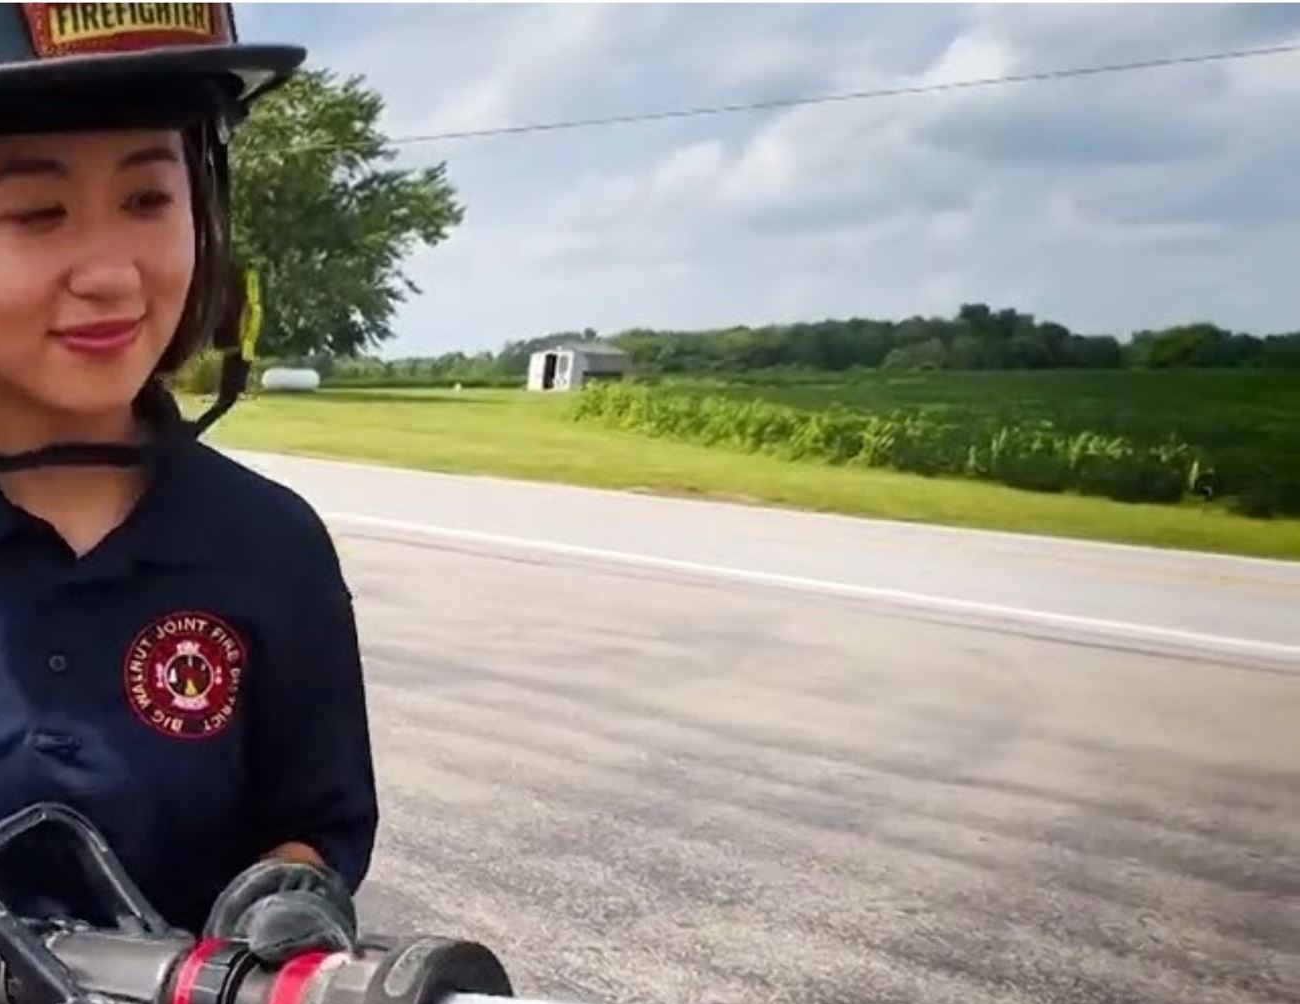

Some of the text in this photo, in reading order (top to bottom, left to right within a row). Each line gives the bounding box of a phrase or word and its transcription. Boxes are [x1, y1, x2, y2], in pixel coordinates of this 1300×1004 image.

[57, 2, 207, 35] FIREFIGHTER
[155, 617, 208, 640] JOINT
[211, 627, 241, 661] FIRE
[129, 639, 153, 709] WALNUT
[151, 709, 184, 732] BIG
